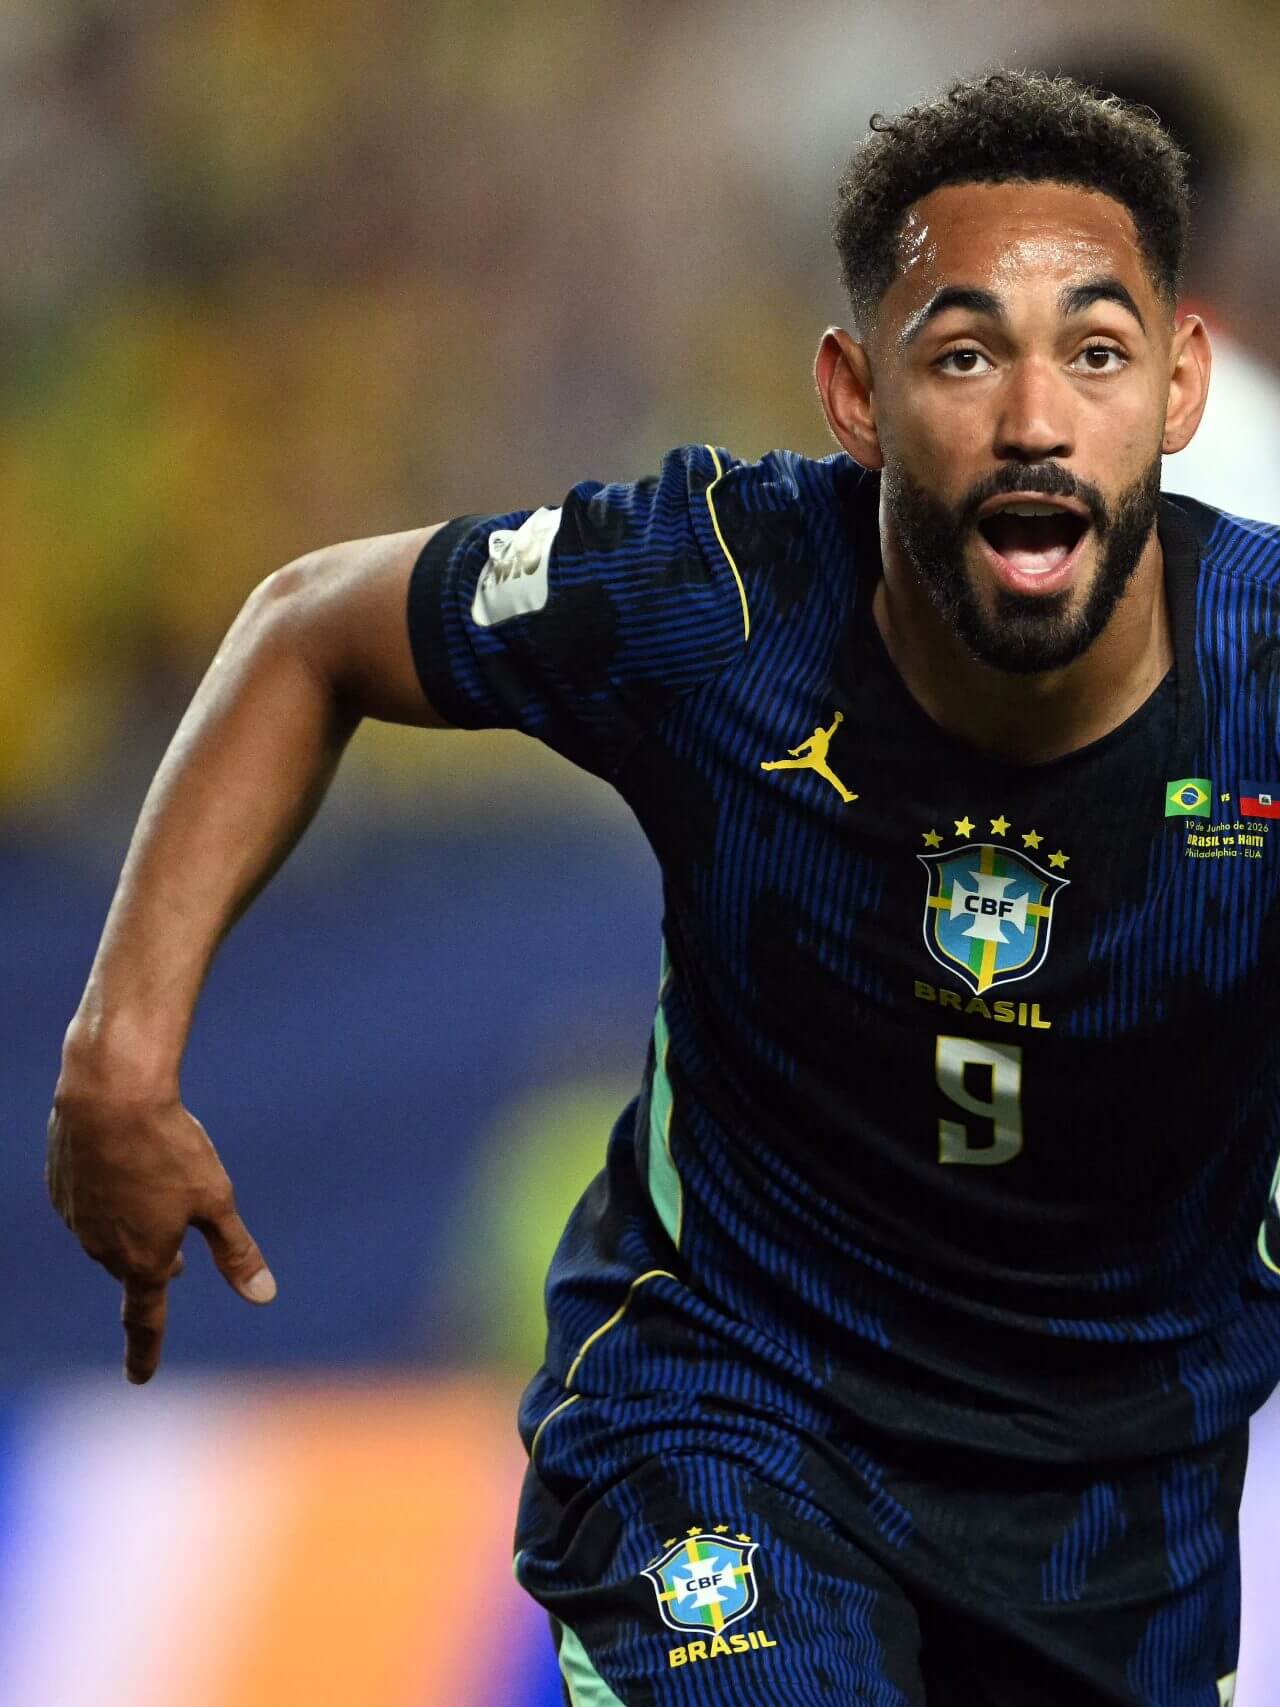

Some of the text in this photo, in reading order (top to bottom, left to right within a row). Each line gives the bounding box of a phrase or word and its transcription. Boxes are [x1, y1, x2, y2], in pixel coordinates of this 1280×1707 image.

[1185, 820, 1269, 833] 19 de Junho de 2026
[1185, 847, 1237, 859] Philadelphia
[1244, 848, 1262, 858] EUA
[964, 895, 1014, 918] CBF
[914, 980, 1051, 1029] BRASIL
[936, 1035, 1023, 1165] 9
[686, 1573, 722, 1592] CBF
[669, 1630, 776, 1668] BRASIL
